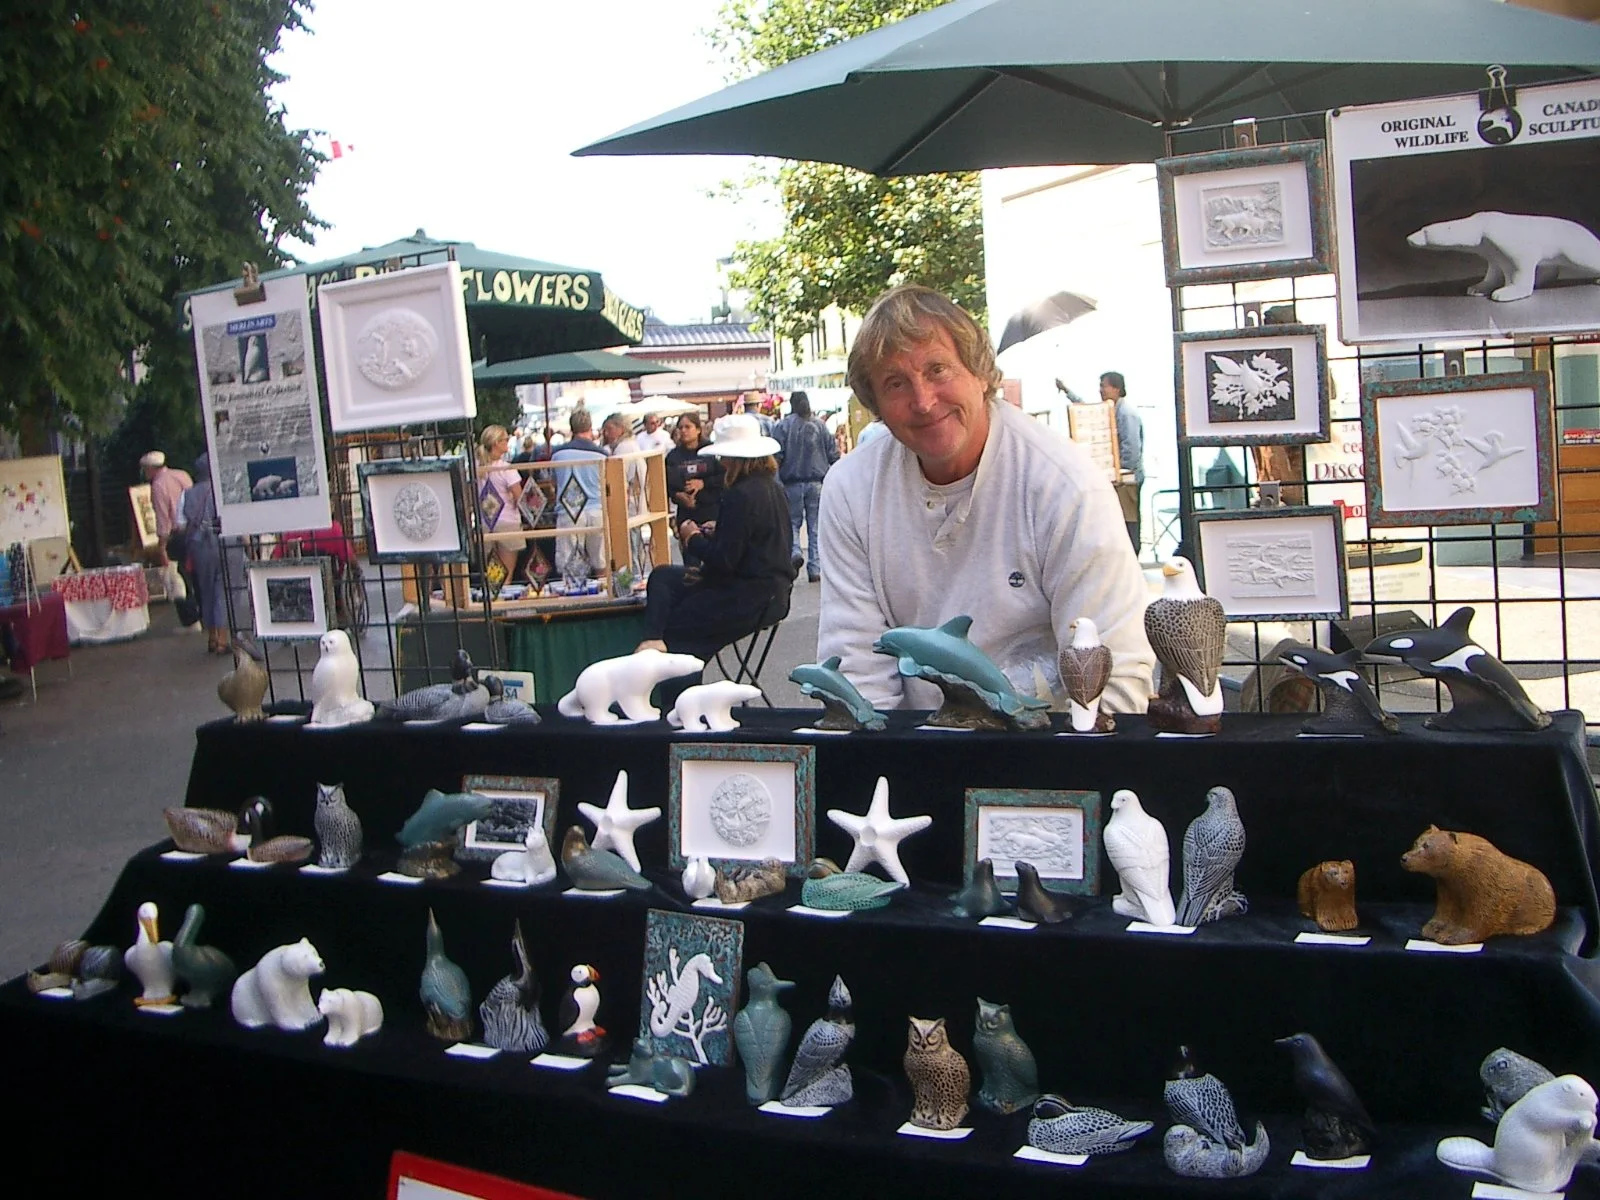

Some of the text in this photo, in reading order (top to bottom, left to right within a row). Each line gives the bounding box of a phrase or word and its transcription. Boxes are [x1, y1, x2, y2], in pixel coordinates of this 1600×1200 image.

[1542, 99, 1600, 117] CANAD
[1381, 115, 1456, 133] ORIGINAL
[1394, 131, 1469, 149] WILDLIFE
[460, 269, 590, 311] FLOWERS
